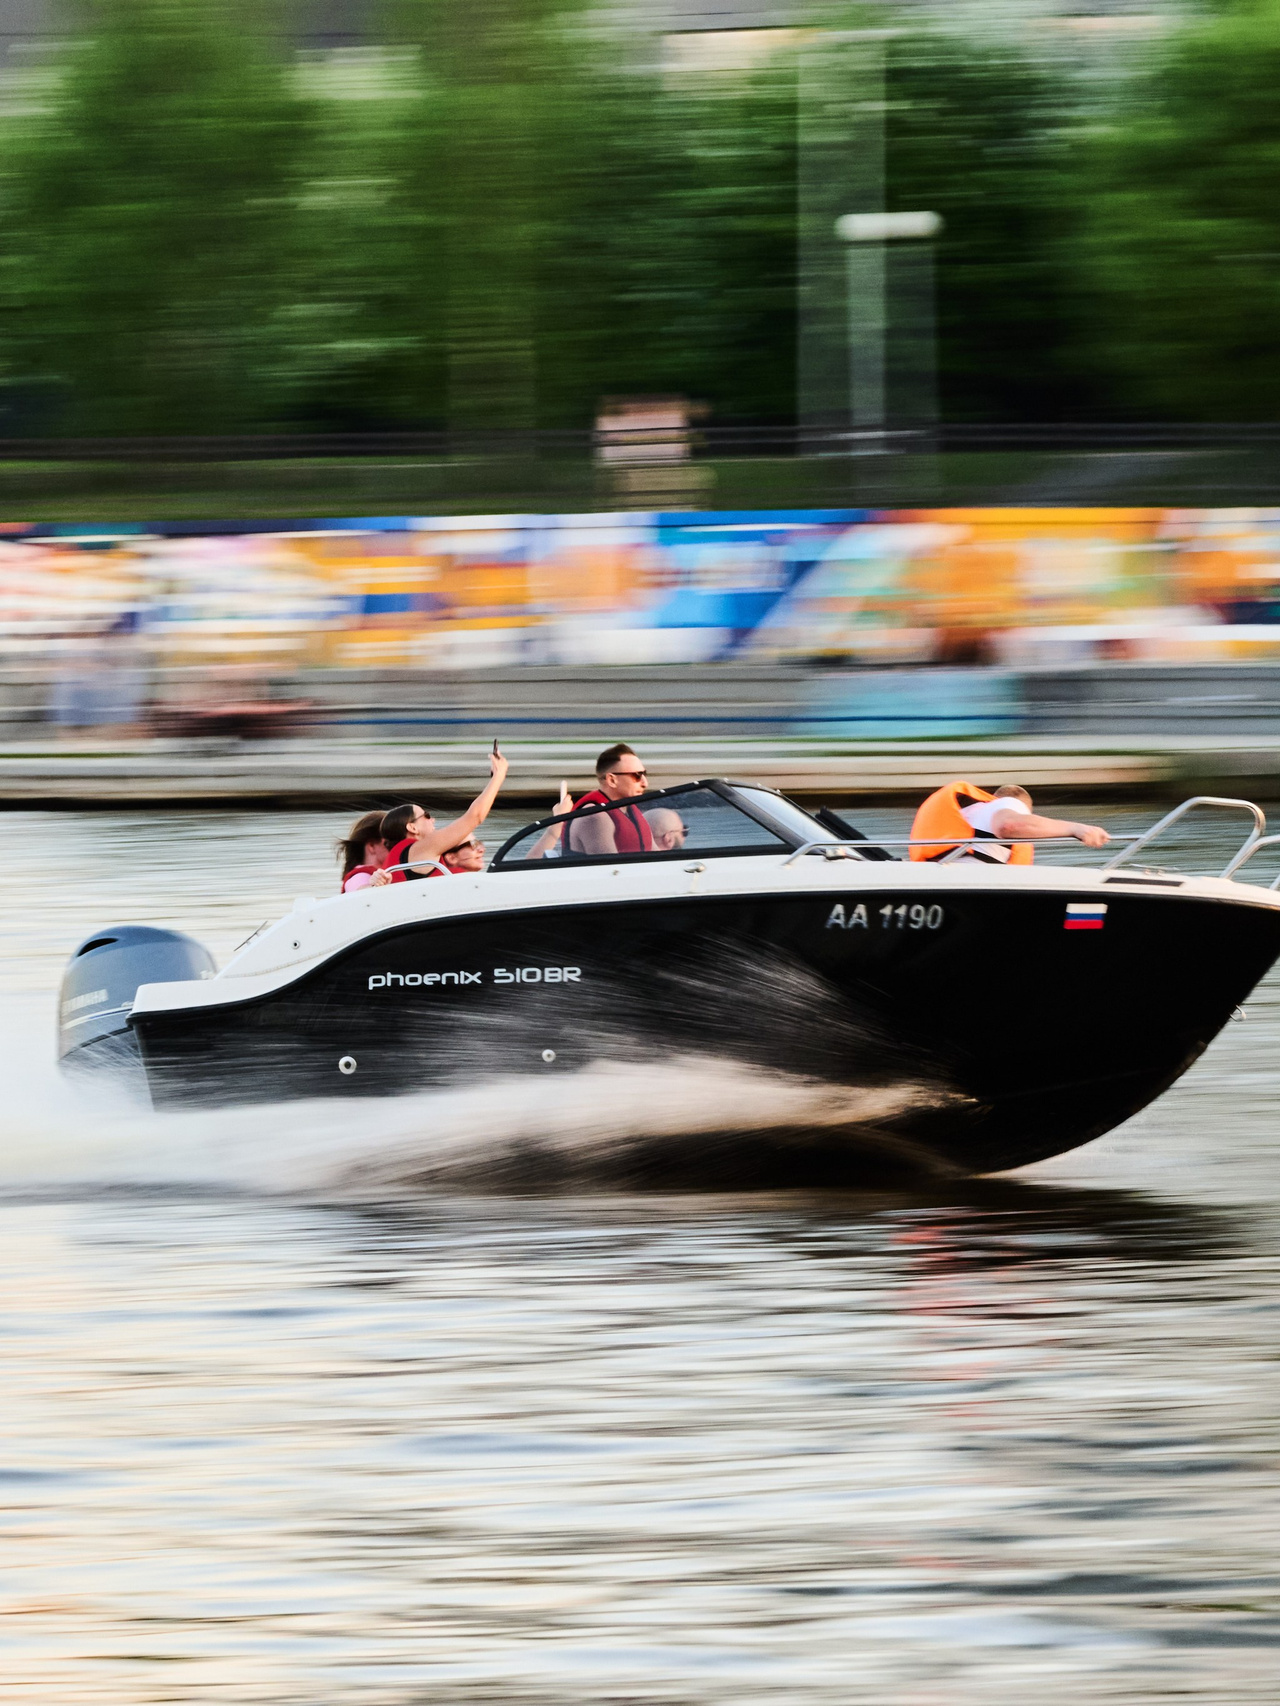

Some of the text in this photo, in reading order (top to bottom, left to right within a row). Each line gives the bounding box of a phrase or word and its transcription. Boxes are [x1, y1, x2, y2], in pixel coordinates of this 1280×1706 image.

[825, 903, 945, 929] AA 1190
[368, 966, 582, 991] phoenix 510BR
